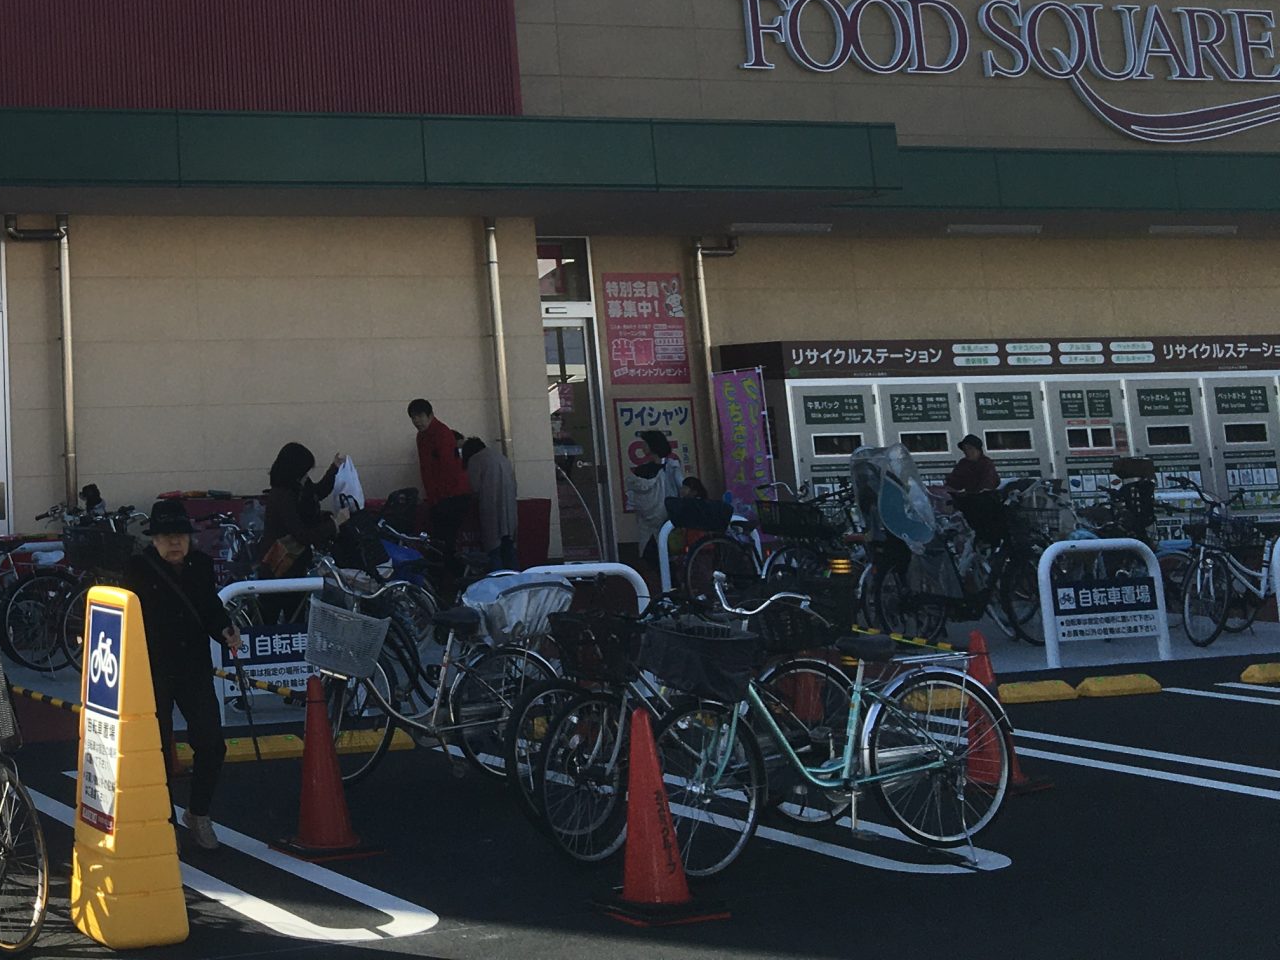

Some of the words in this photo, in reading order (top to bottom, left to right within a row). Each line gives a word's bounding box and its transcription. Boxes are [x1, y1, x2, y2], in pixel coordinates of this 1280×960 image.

[606, 281, 660, 297] 特別会員
[791, 348, 942, 365] リサイクルステーション
[619, 406, 689, 427] ワイシャツ
[1079, 585, 1151, 607] 自転車置場
